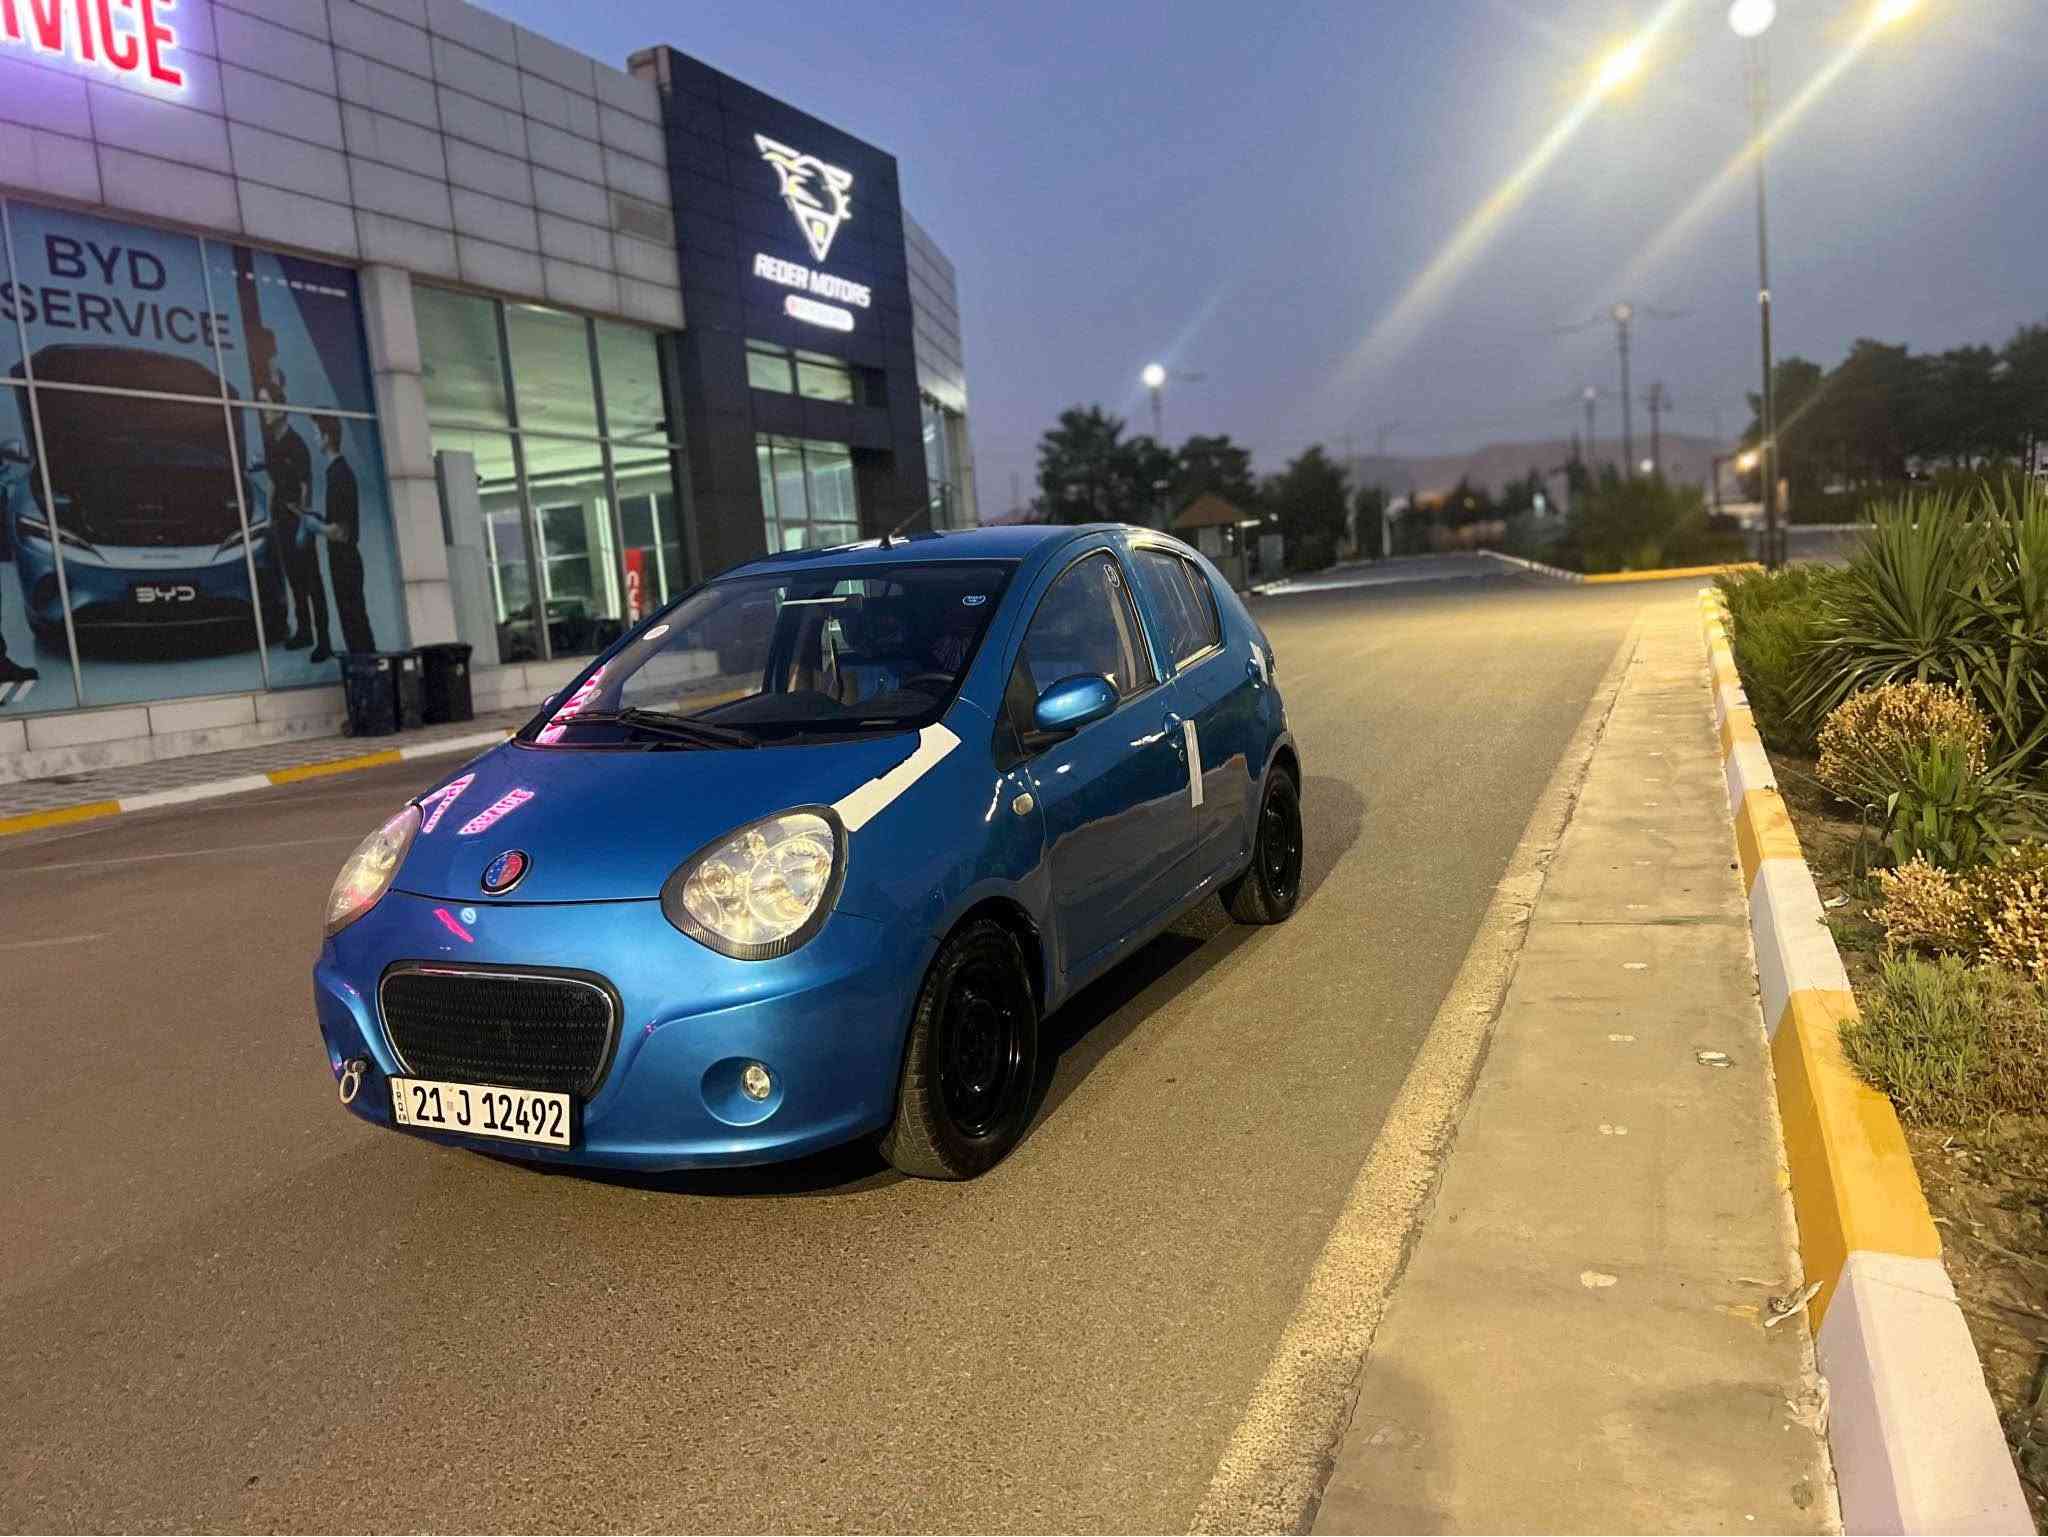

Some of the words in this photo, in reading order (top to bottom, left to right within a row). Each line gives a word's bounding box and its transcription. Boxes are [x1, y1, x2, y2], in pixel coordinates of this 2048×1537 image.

[46, 234, 166, 291] BYD
[809, 271, 871, 308] MOTORS
[1, 282, 234, 350] SERVICE
[135, 586, 195, 603] BYD
[413, 1086, 445, 1122] 21
[457, 1090, 471, 1125] J
[482, 1093, 564, 1138] 12492
